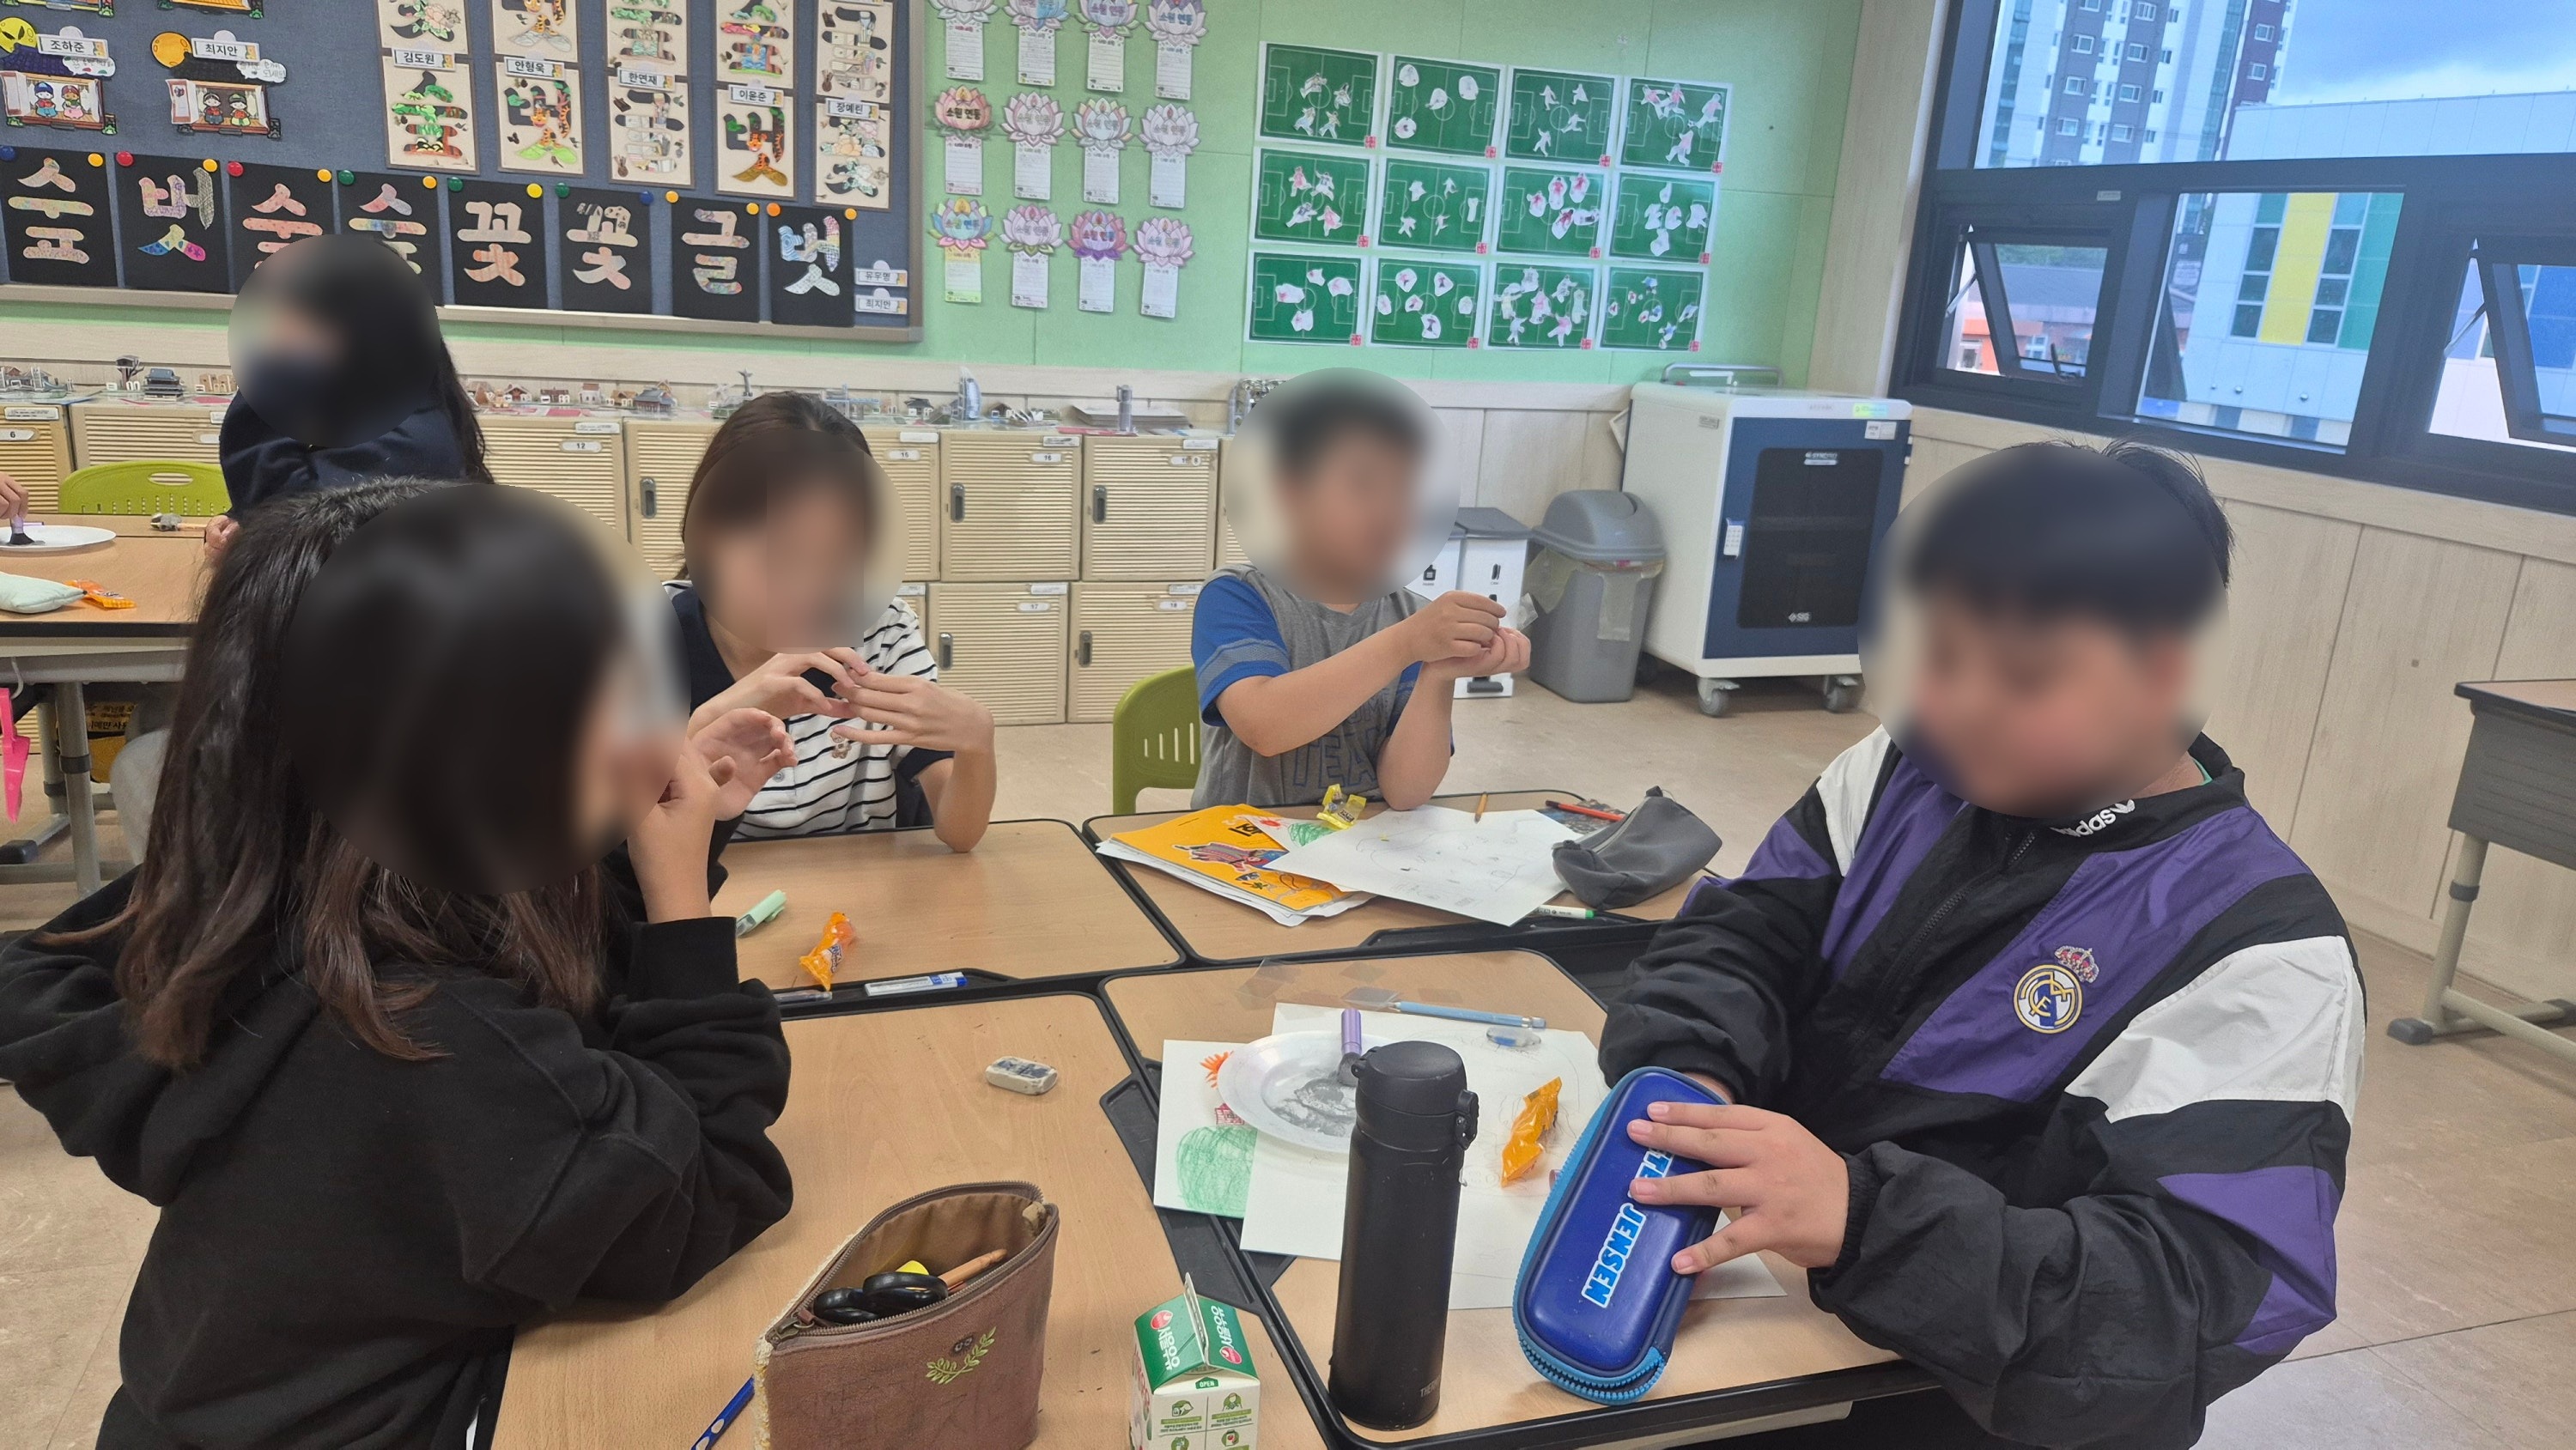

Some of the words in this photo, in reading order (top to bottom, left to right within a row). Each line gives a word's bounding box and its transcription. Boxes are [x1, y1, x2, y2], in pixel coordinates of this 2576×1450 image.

[50, 39, 85, 53] 조하준
[205, 43, 238, 57] 최지안
[403, 52, 435, 65] 김도원
[514, 60, 545, 74] 안형욱
[945, 107, 963, 118] 소원
[137, 167, 215, 262] 벗
[457, 201, 532, 287] 꽃
[566, 202, 639, 291] 꽃
[681, 208, 750, 295] 글
[777, 215, 841, 297] 벗
[1581, 1203, 1647, 1309] JENSEN
[1157, 1326, 1181, 1371] 서울우유
[1201, 1305, 1235, 1350] 서울우유
